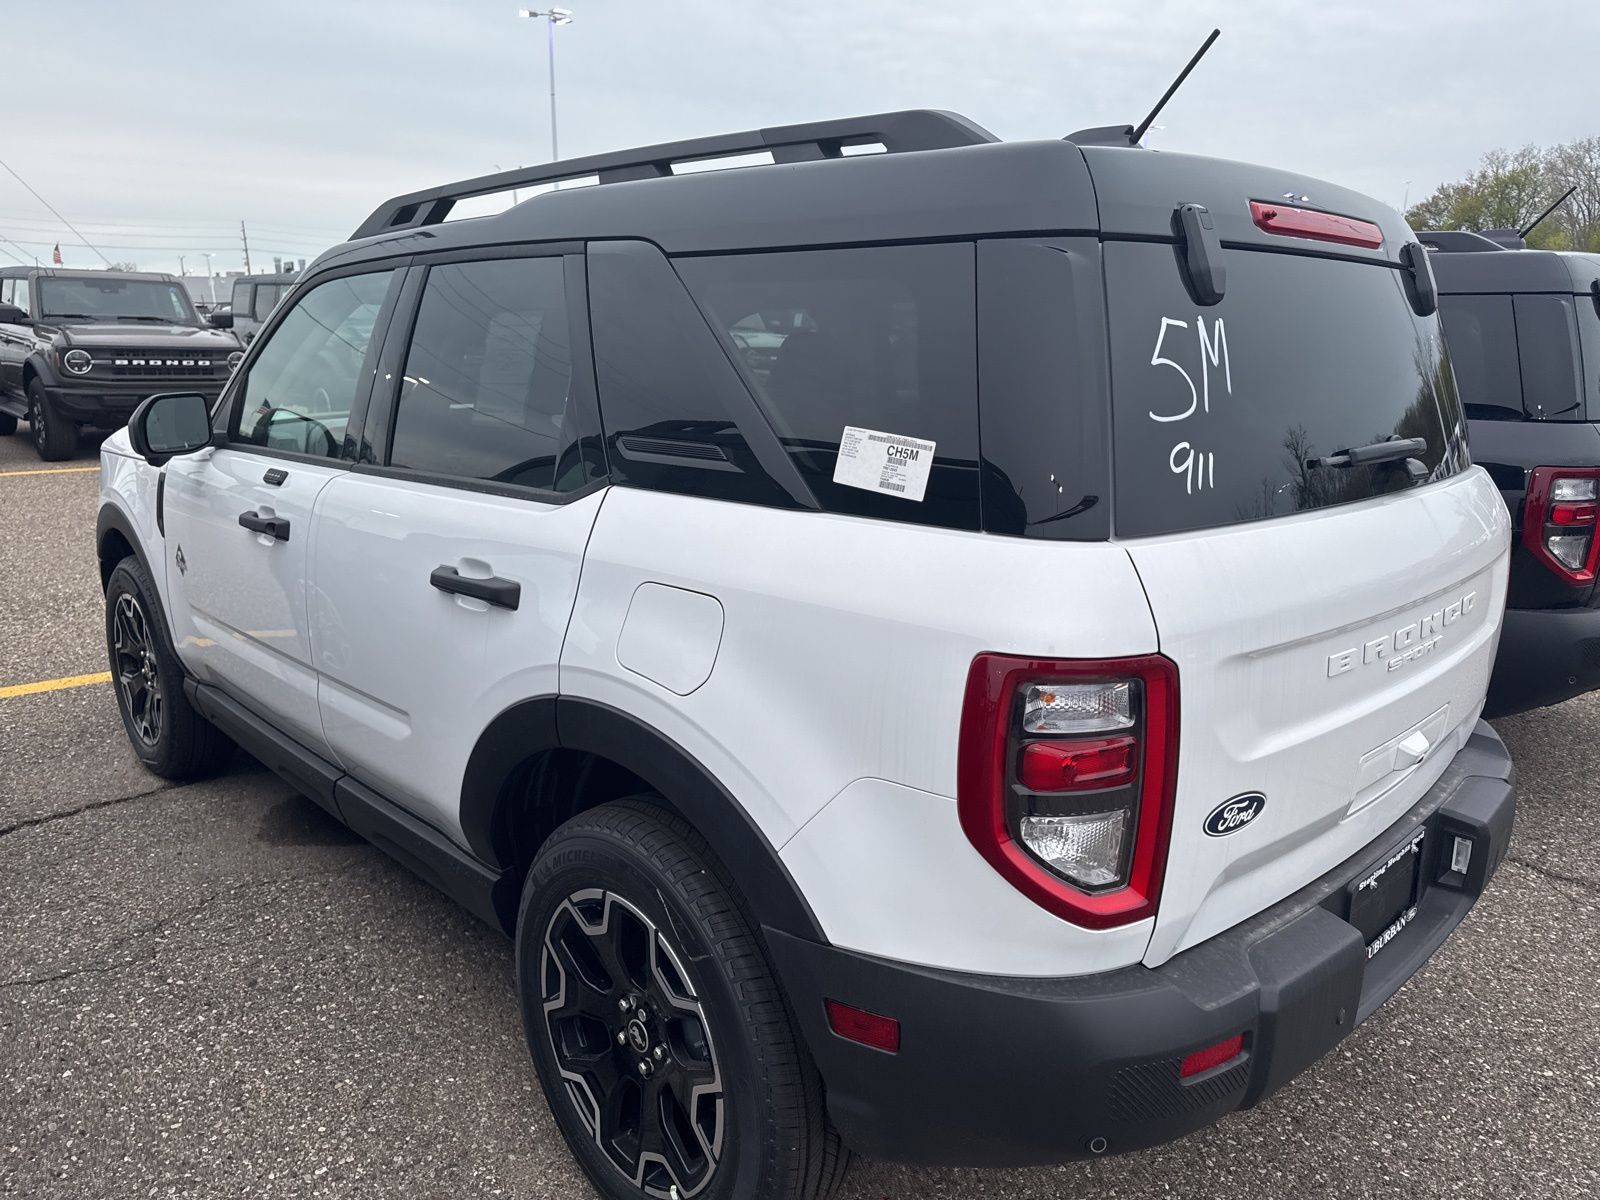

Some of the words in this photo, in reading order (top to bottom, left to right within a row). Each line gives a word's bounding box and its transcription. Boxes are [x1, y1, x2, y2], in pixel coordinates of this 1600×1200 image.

[1149, 315, 1232, 422] 5M
[886, 445, 920, 462] CH5M
[1169, 441, 1214, 495] 911
[1326, 591, 1477, 678] BRONCO
[1386, 635, 1443, 672] SPORT
[1217, 800, 1258, 831] Ford
[1366, 912, 1407, 959] UBURBAN
